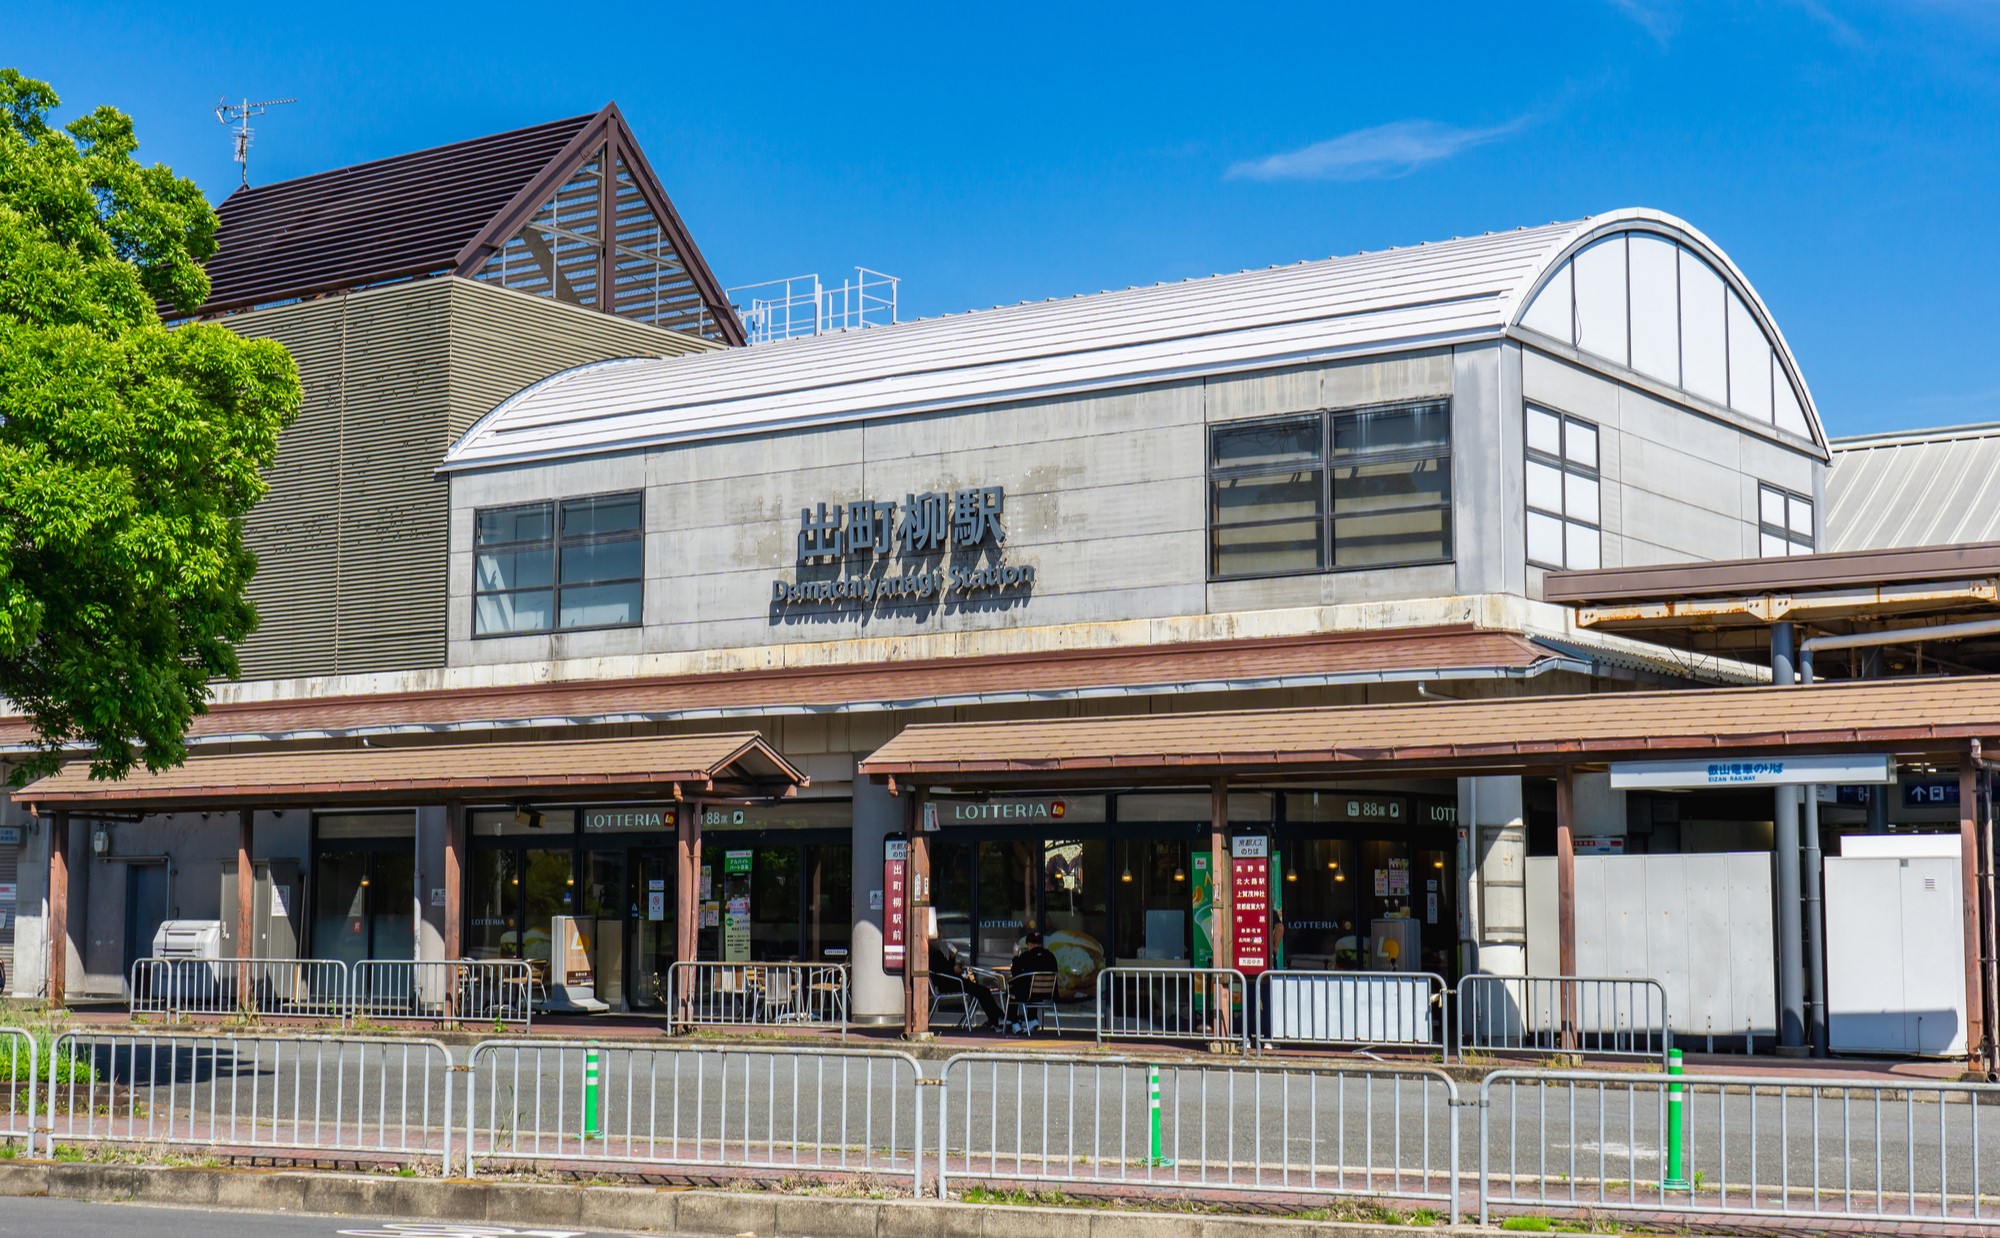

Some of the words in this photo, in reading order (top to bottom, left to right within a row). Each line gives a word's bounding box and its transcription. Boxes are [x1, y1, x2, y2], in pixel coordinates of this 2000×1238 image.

[800, 486, 1005, 560] 出町柳駅
[772, 568, 942, 602] Demachiyanagi
[948, 562, 1035, 590] Station
[955, 803, 1047, 819] LOTTERIA
[586, 813, 661, 828] LOTTERIA
[892, 864, 902, 941] 出町柳駅前
[471, 918, 505, 926] LOTTERIA
[979, 920, 1024, 928] LOTTERIA
[1288, 921, 1339, 929] LOTTERIA
